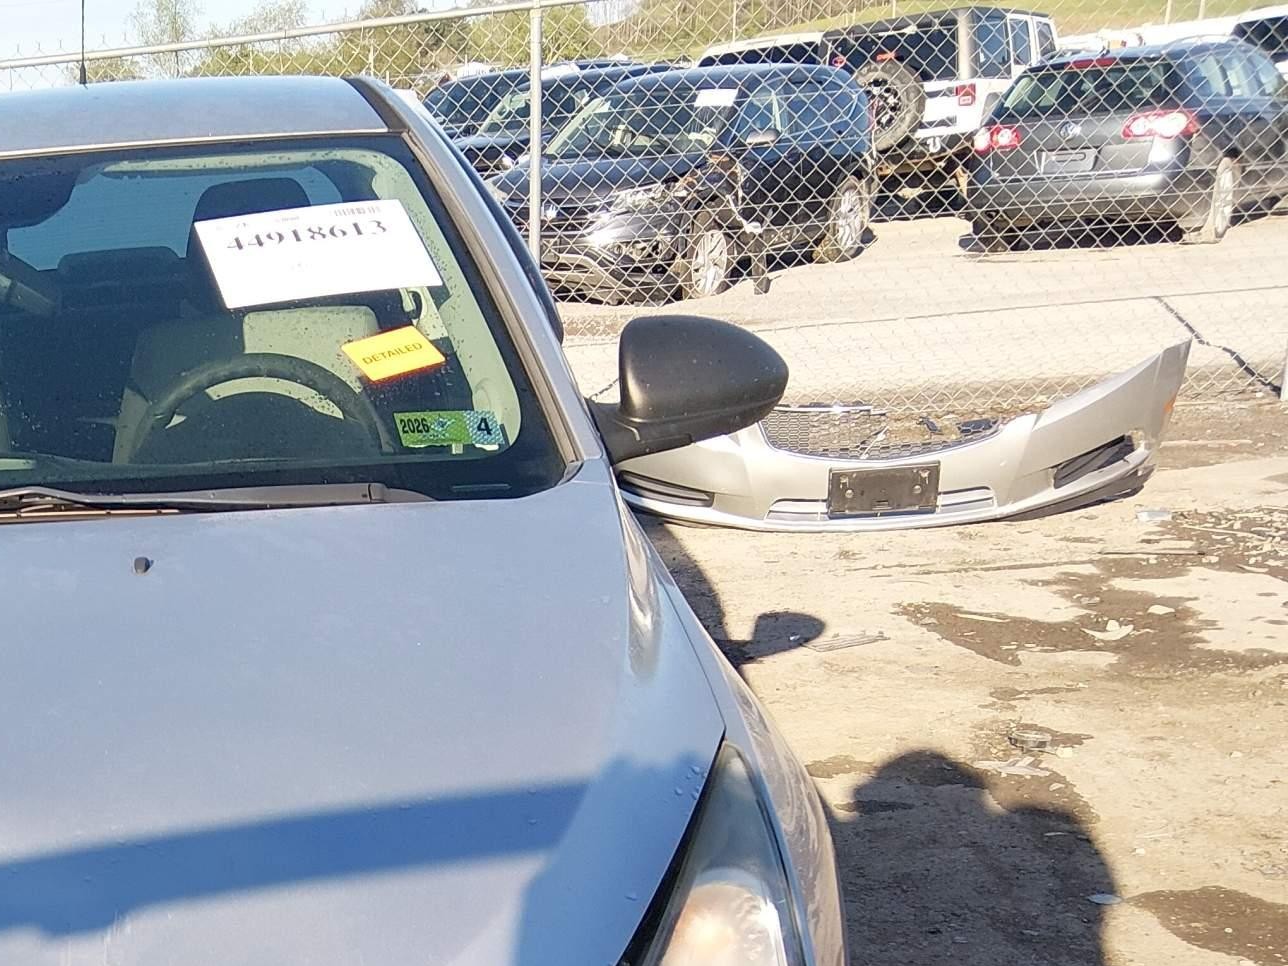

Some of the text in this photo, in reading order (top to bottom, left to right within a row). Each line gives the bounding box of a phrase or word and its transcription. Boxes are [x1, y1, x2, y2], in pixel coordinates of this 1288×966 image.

[227, 219, 388, 251] 44918613
[362, 342, 424, 365] DETAILED
[400, 417, 492, 436] 2026 4
